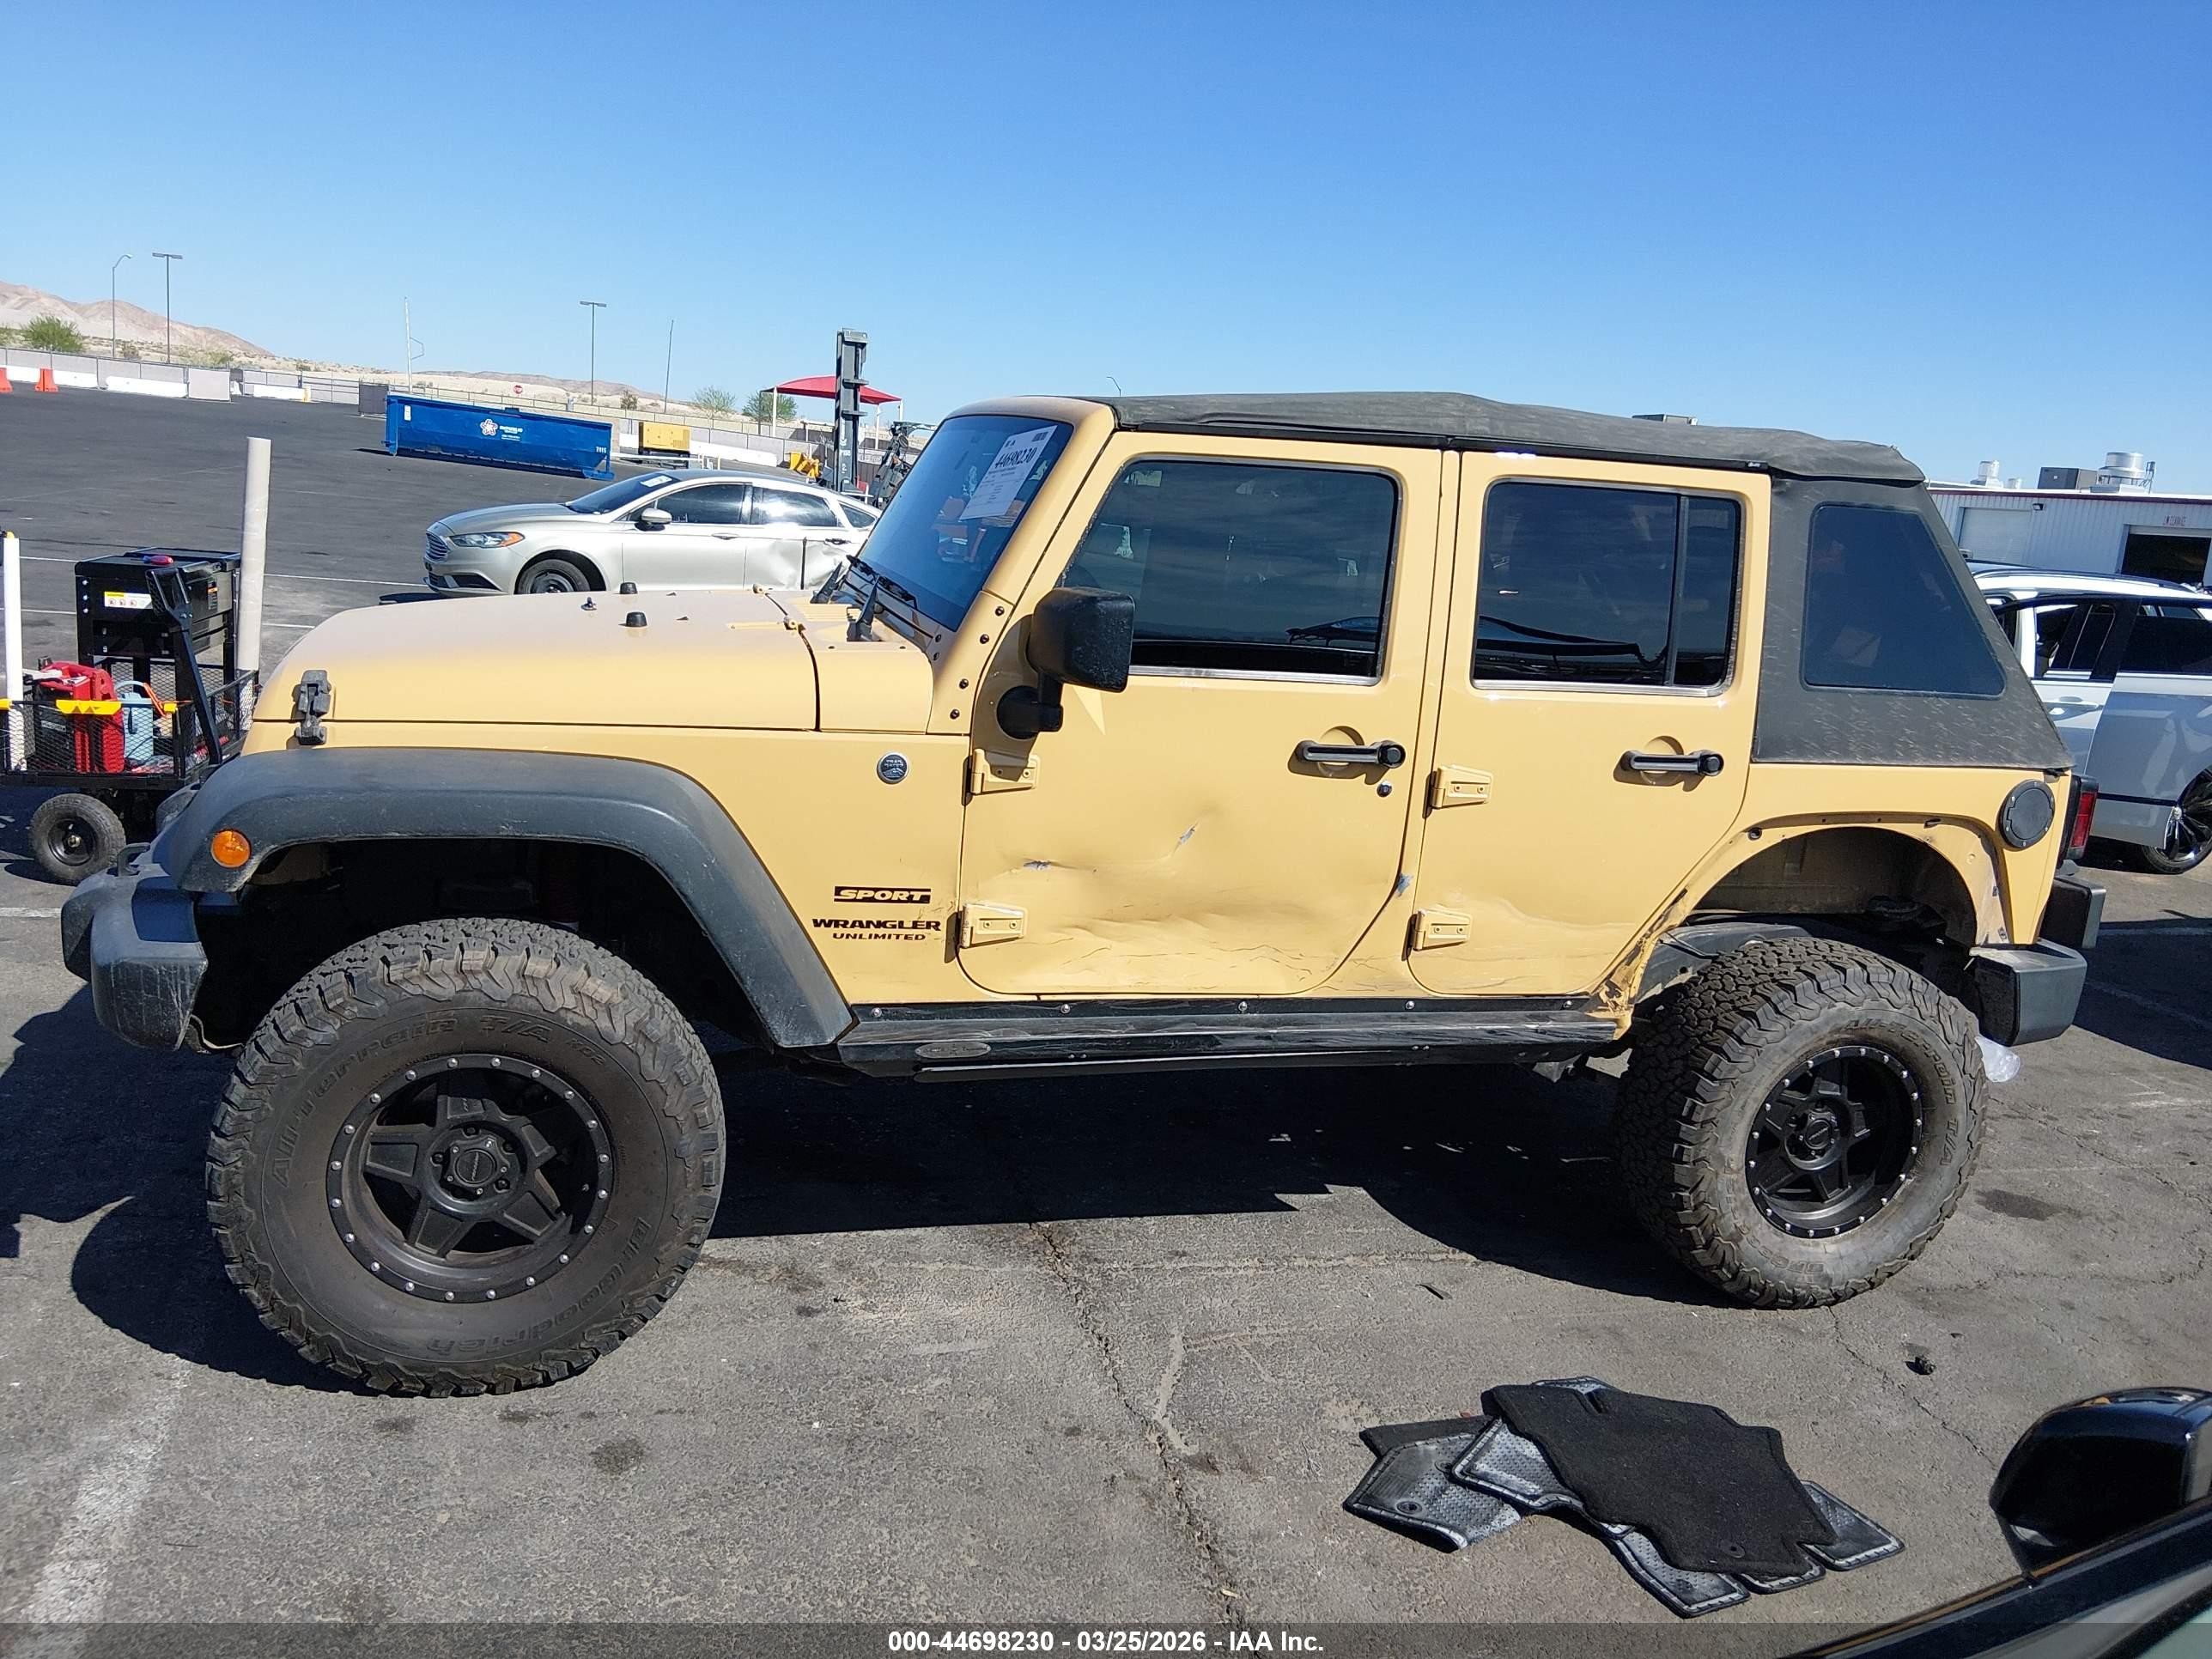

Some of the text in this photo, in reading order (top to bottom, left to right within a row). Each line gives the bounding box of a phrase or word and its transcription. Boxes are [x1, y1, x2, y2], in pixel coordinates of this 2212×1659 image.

[838, 888, 931, 902] SPORT
[811, 918, 942, 932] WRANGLER
[832, 932, 927, 941] UNLIMITED
[479, 1015, 553, 1043] T/A
[1940, 1117, 1959, 1166] T/A
